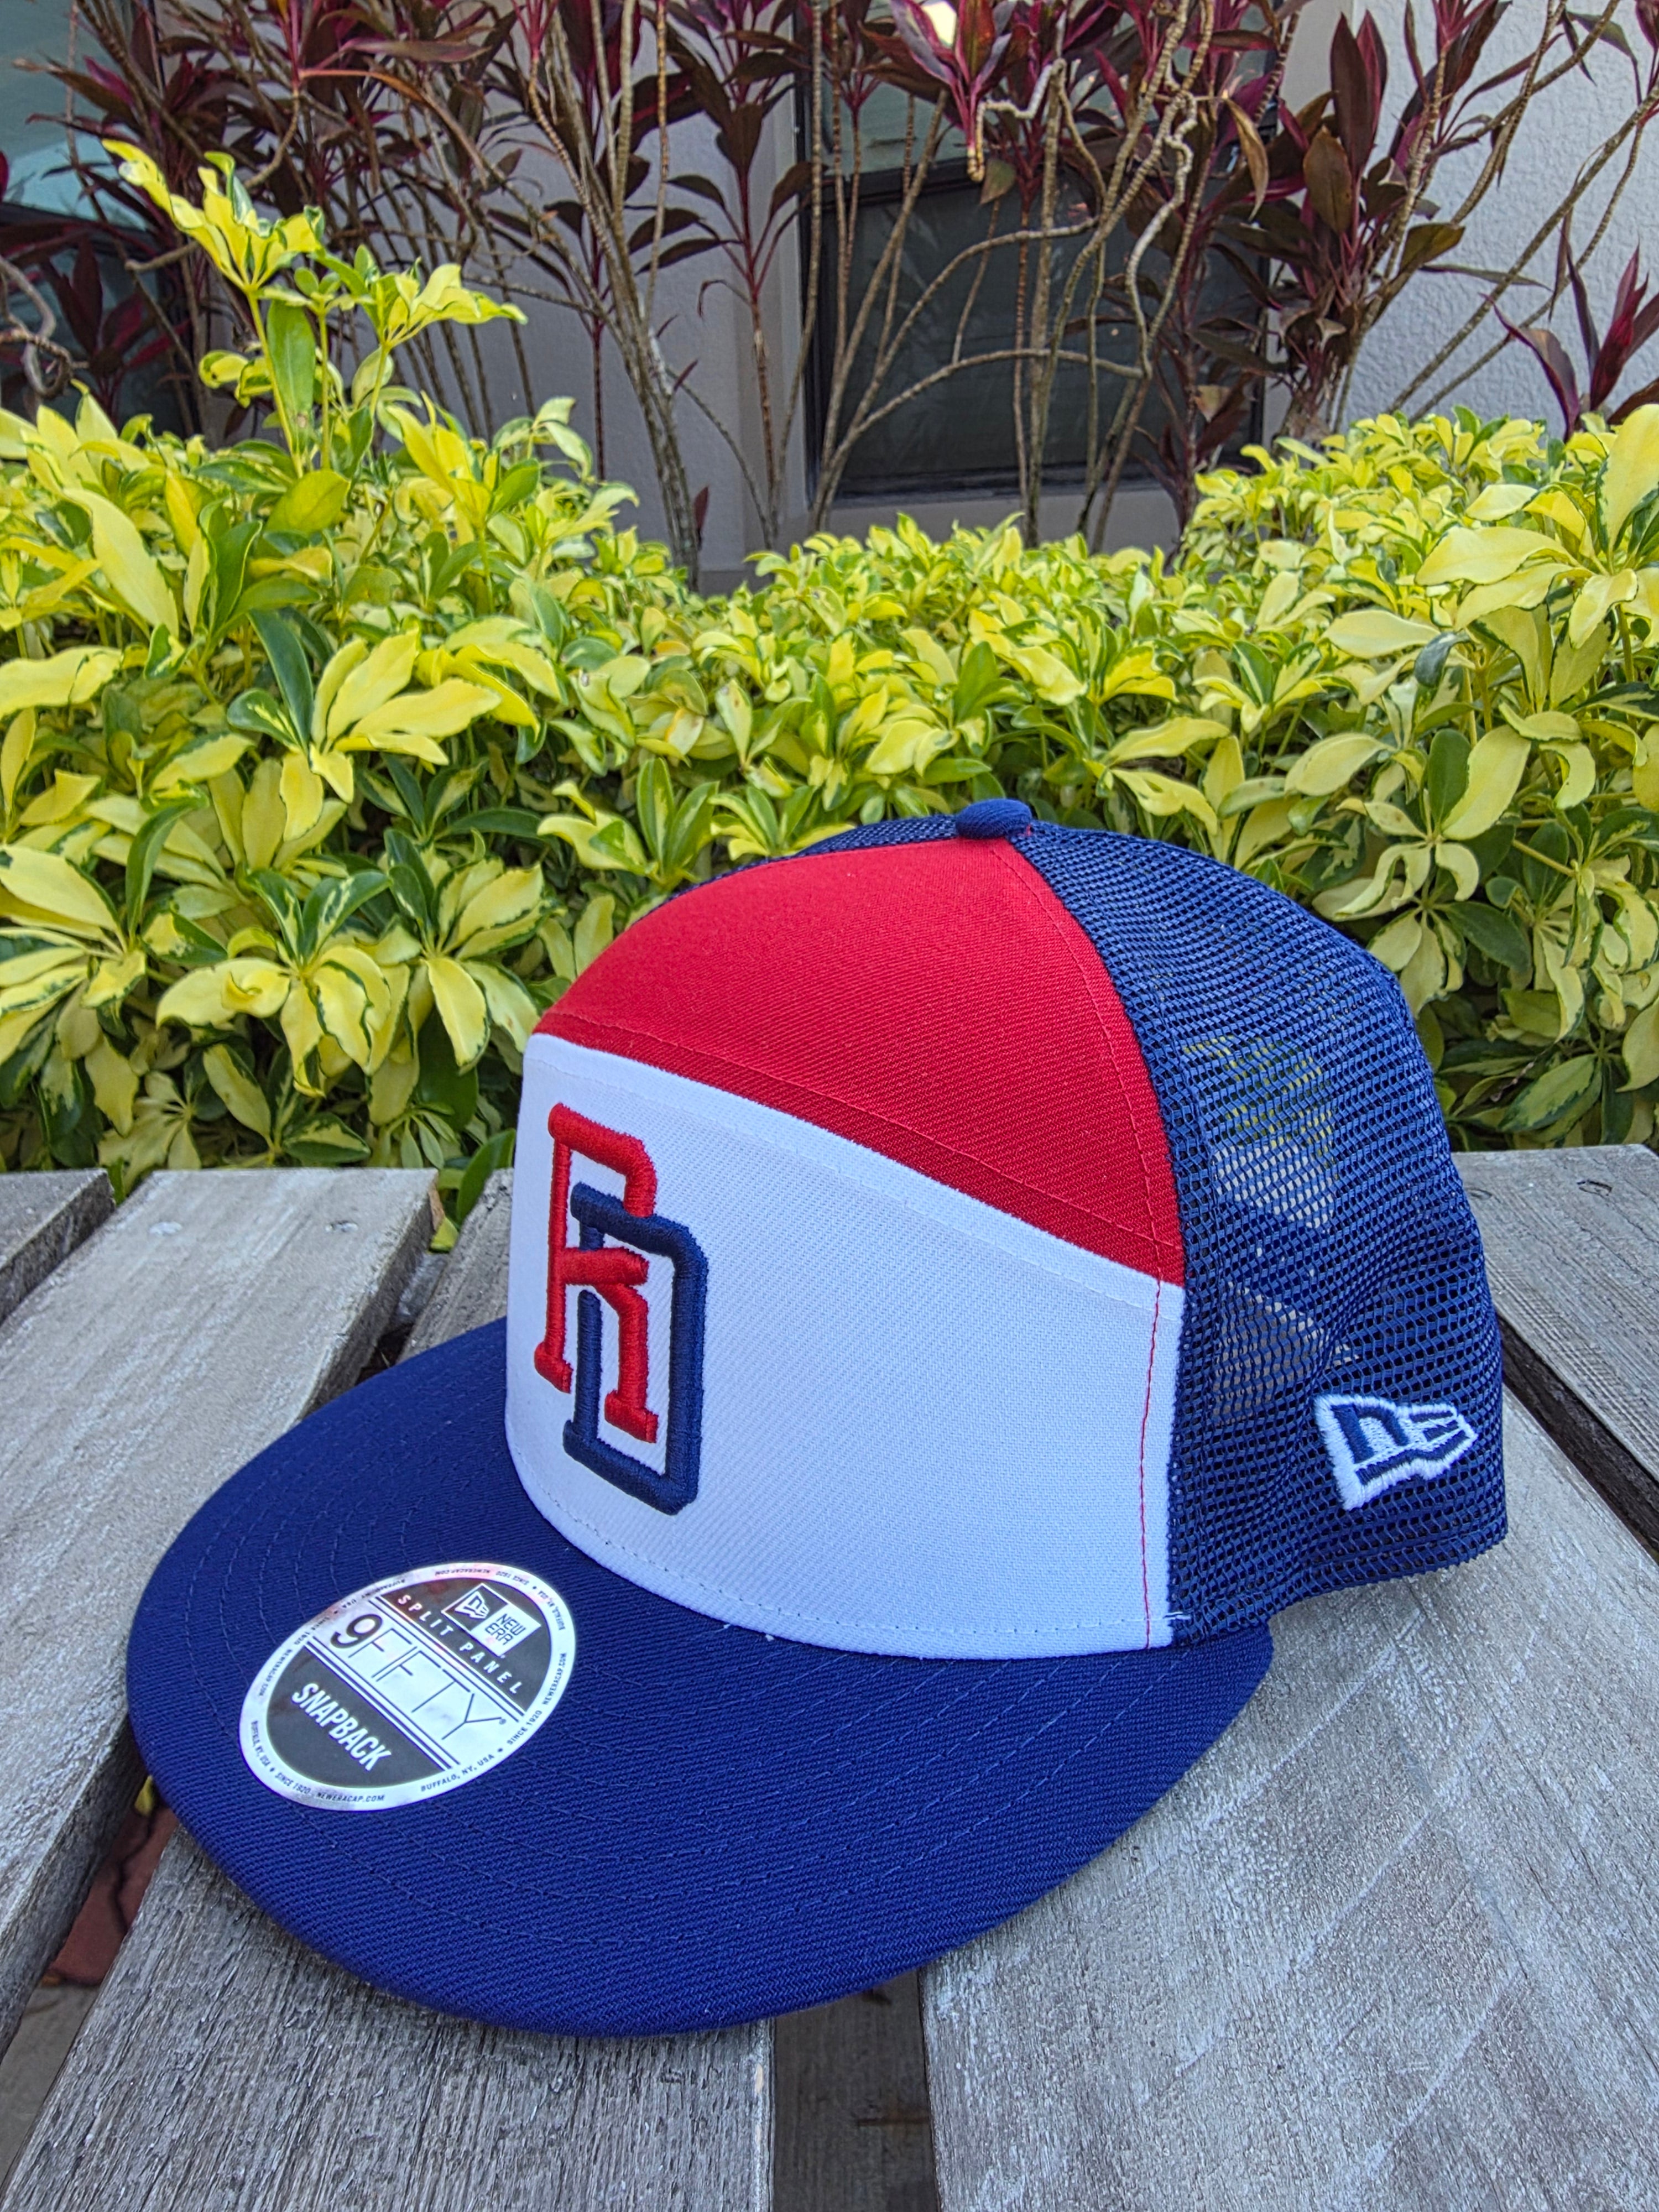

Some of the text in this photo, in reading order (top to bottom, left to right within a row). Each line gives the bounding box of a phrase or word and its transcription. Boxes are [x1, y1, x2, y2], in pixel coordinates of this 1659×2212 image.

[398, 1594, 523, 1694] SPLIT PANEL
[485, 1623, 514, 1646] ERA
[496, 1613, 527, 1636] NEW
[291, 1683, 392, 1771] SNAPBACK
[420, 1773, 461, 1792] BUFFALO,
[461, 1766, 477, 1775] NY,
[477, 1754, 495, 1766] USA
[507, 1726, 528, 1745] SINCE
[525, 1709, 542, 1726] 1920
[316, 1791, 385, 1803] NEWERACAP.COM
